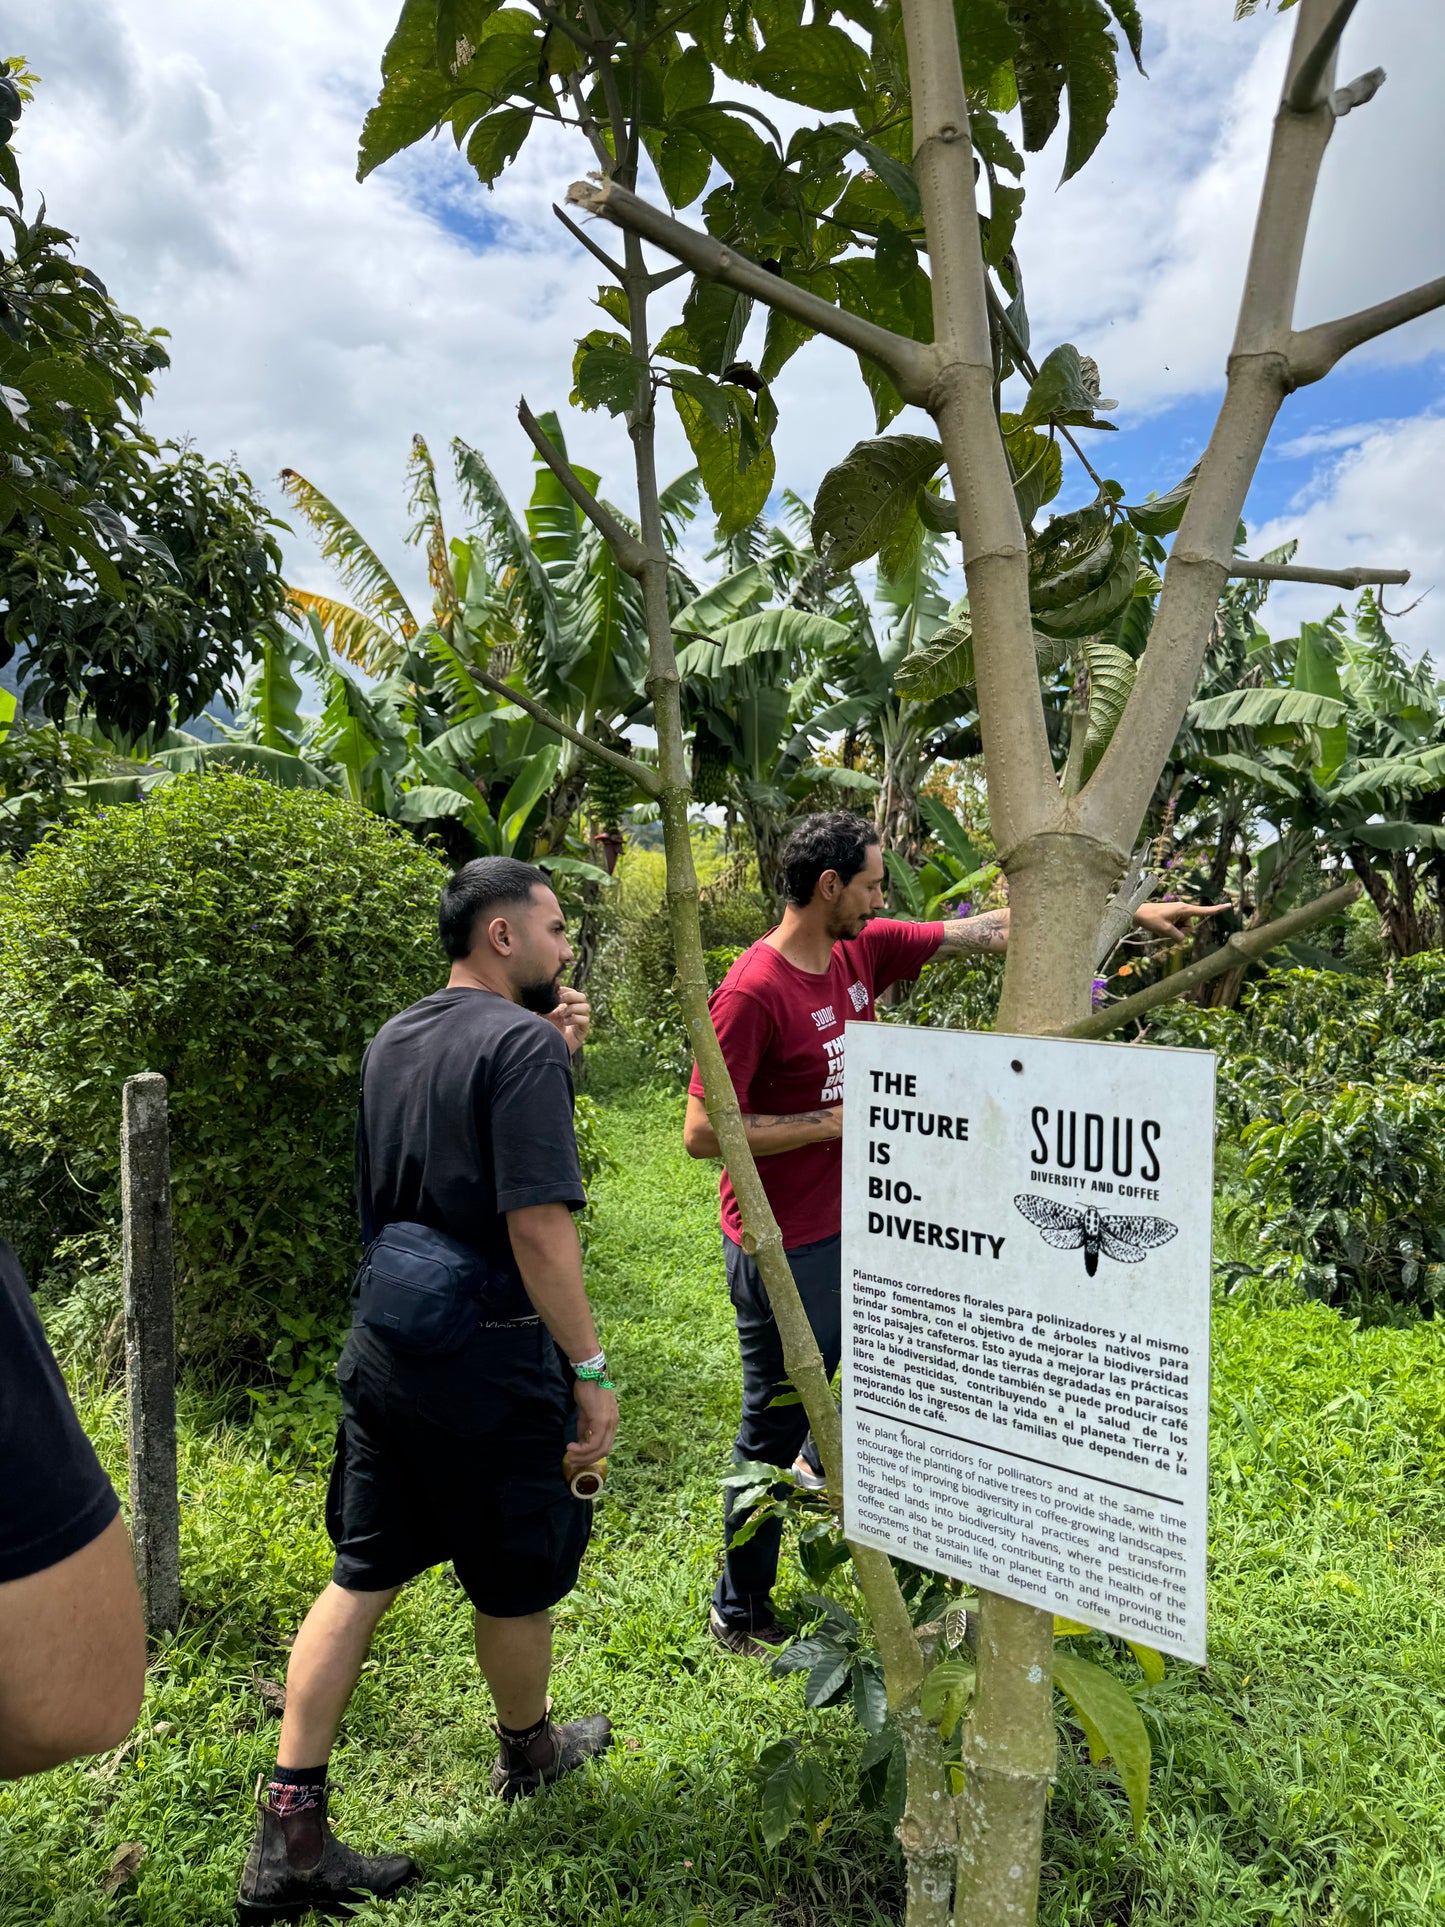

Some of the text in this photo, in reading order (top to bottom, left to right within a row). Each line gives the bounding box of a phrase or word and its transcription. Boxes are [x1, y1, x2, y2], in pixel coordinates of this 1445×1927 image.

[869, 1070, 917, 1098] THE
[869, 1105, 969, 1142] FUTURE
[868, 1175, 922, 1205] BIO-
[869, 1140, 891, 1165] IS
[1030, 1106, 1161, 1183] SUDUS
[1030, 1170, 1161, 1202] DIVERSITY AND COFFEE
[868, 1211, 1006, 1260] DIVERSITY
[852, 1310, 1188, 1401] en los paisajes cafeteros. Esto ayuda a mejorar las prácticas
[853, 1269, 1189, 1355] Plantamos corredores florales para polinizadores y al mismo
[853, 1282, 1189, 1370] tiempo fomentamos la siembra de árboles nativos para
[853, 1294, 1188, 1386] brindar sombra, con el objetivo de mejorar la biodiversidad
[853, 1323, 1188, 1416] agrícolas y a transformar las tierras degradadas en paraísos
[853, 1336, 1188, 1431] para la biodiversidad, donde también se puede producir café
[853, 1346, 1188, 1446] libre de pesticidas, contribuyendo a la salud de los
[853, 1388, 947, 1422] producción de café.
[853, 1362, 1187, 1463] ecosistemas que sustentan la vida en el planeta Tierra y,
[853, 1375, 1187, 1476] mejorando los ingresos de las familias que dependen de la
[856, 1421, 1186, 1529] We plant floral corridors for pollinators and at the same time
[857, 1451, 1186, 1562] objective of improving biodiversity in coffee-growing landscapes.
[857, 1463, 1186, 1578] This helps to improve agricultural practices and transform
[858, 1478, 1186, 1594] degraded lands into biodiversity havens, where pesticide-free
[858, 1508, 1186, 1626] ecosystems that sustain life on planet Earth and improving the
[859, 1520, 1185, 1642] income of the families that depend on coffee production.
